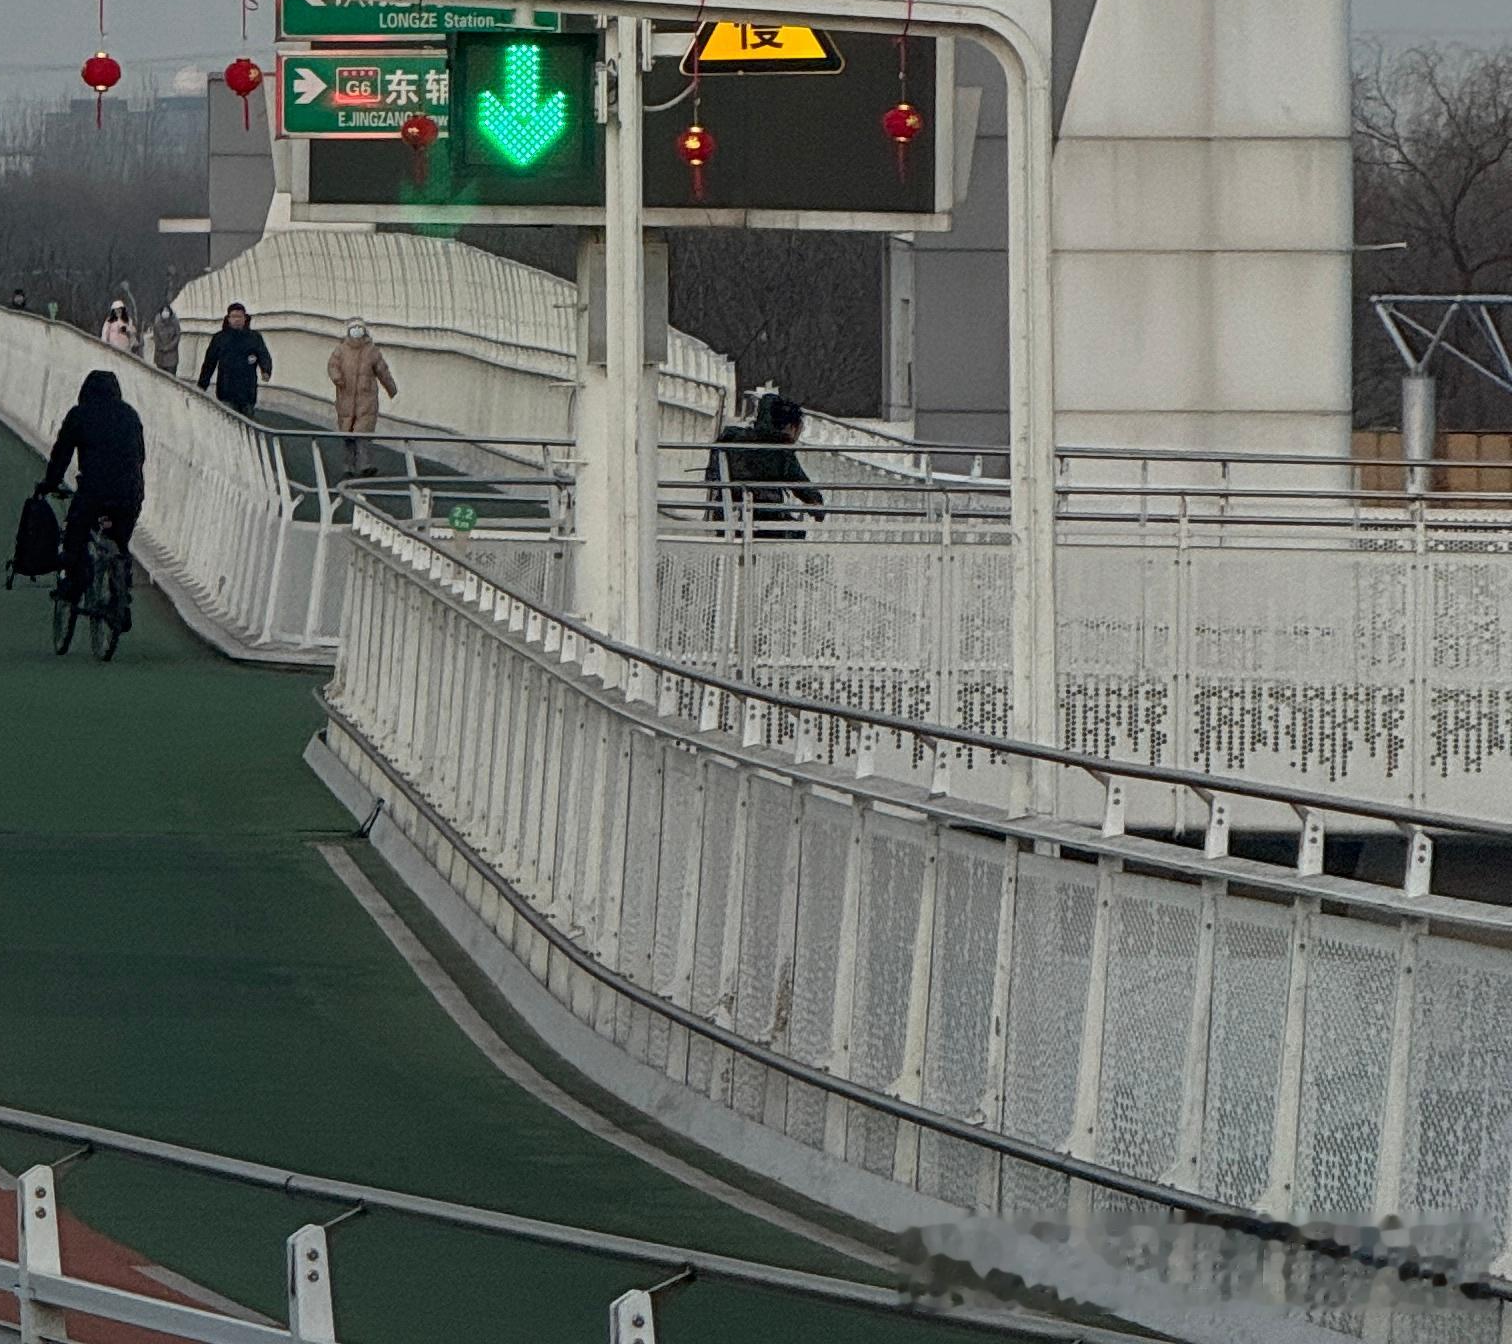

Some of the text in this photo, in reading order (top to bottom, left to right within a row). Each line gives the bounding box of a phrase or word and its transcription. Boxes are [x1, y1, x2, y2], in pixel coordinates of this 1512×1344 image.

[379, 12, 495, 28] LONGZE Station
[346, 80, 371, 96] G6
